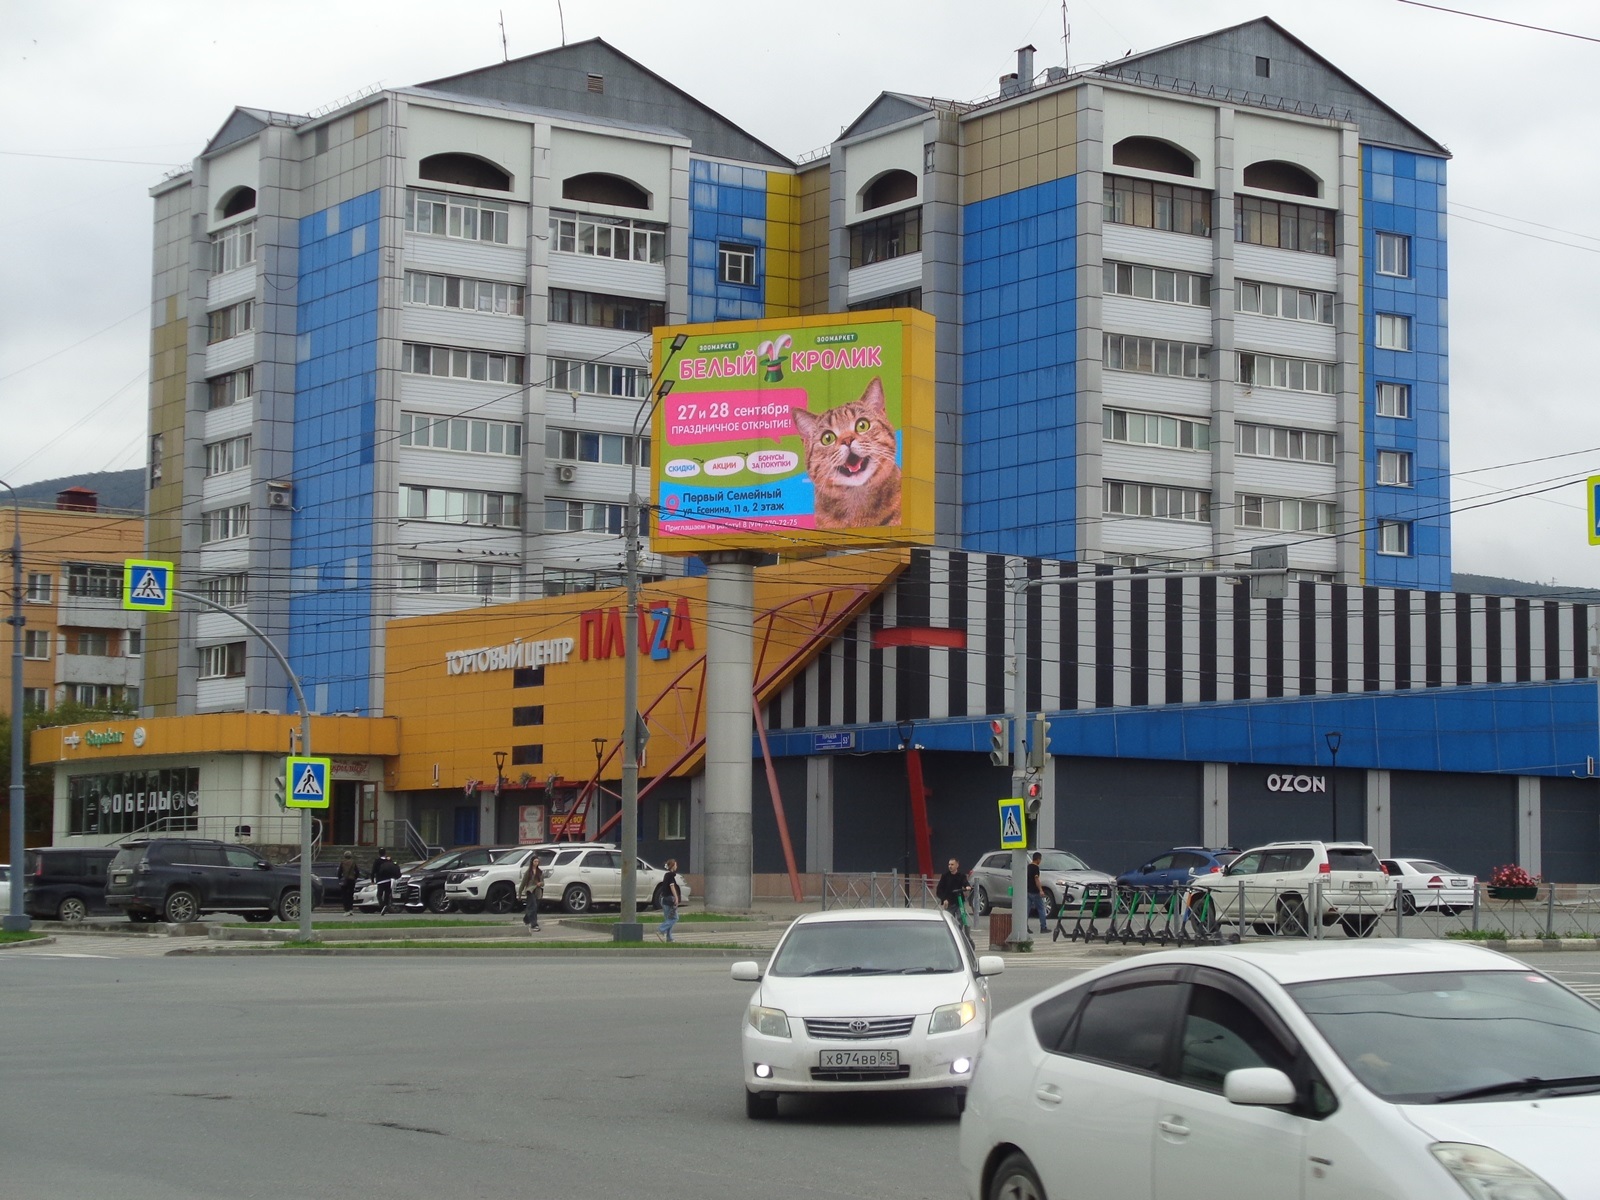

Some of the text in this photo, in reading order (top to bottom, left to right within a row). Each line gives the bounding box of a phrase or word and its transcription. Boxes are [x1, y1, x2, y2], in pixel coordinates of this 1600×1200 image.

[816, 334, 855, 343] ЗООМАРКЕТ
[699, 342, 736, 351] ЗООМАРКЕТ
[679, 345, 882, 380] БЕЛЫЙ КРОЛИК
[677, 402, 789, 420] 27 и 28 сентября
[671, 419, 792, 435] ПРАЗДНИЧНОЕ ОТКРЫТИЕ!
[758, 454, 785, 462] БОНУСЫ
[760, 461, 791, 469] ПОКУПКИ
[668, 464, 696, 473] СКИДКИ
[712, 463, 737, 471] АКЦИИ
[682, 488, 782, 504] Первый Семейный
[696, 506, 732, 516] Есенина,
[734, 504, 741, 513] 11
[752, 503, 759, 512] 2
[760, 502, 785, 511] этаж
[664, 523, 706, 533] Приглашаем
[445, 637, 575, 676] ТОРГОВЫЙ ЦЕНТР
[1267, 773, 1326, 793] OZON
[112, 790, 171, 814] ОБЕДЫ
[826, 1051, 893, 1065] Х874ВВ 65
